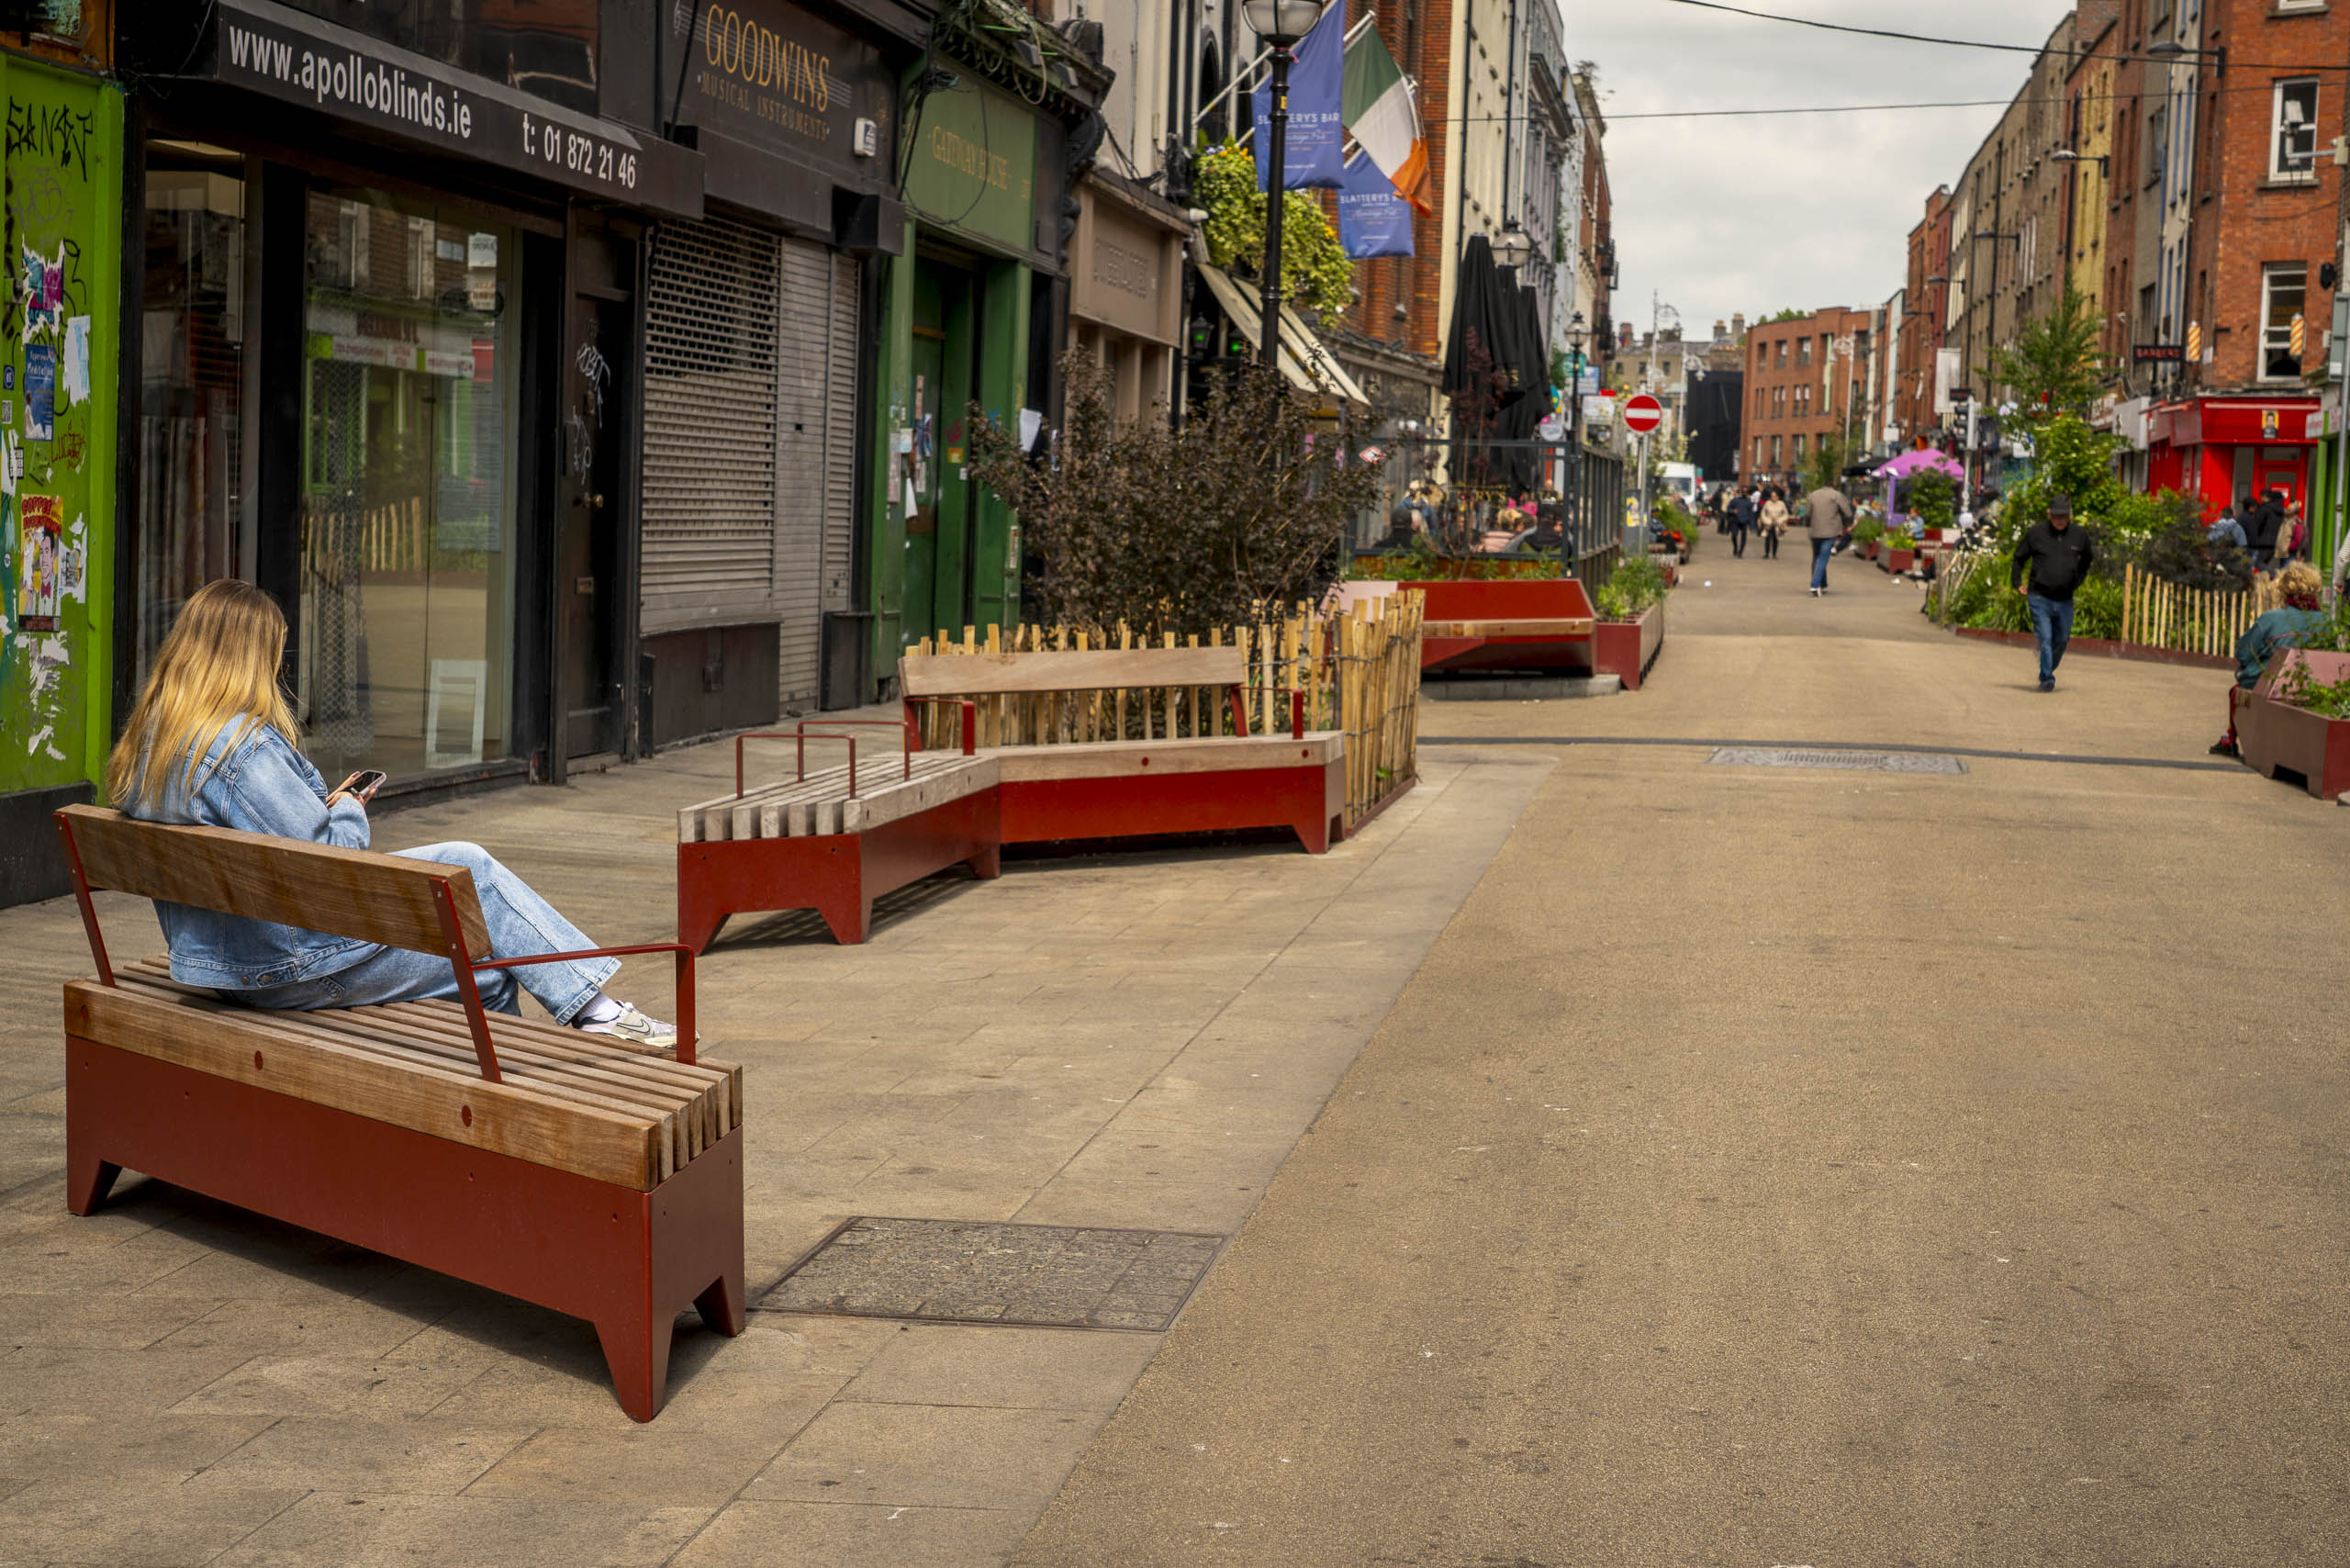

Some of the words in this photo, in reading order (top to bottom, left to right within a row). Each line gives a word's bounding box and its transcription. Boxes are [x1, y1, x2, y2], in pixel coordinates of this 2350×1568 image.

[229, 26, 471, 138] www.apolloblinds.ie
[706, 4, 829, 113] GOODWINS
[700, 71, 750, 111] MUSICAL
[756, 95, 827, 140] INSTRUMENTS
[1321, 112, 1340, 123] BAR
[522, 113, 535, 155] t:
[543, 124, 561, 163] 01
[567, 133, 593, 174] 872
[598, 144, 613, 182] 21
[618, 152, 636, 189] 46
[2136, 347, 2180, 358] BARBERS
